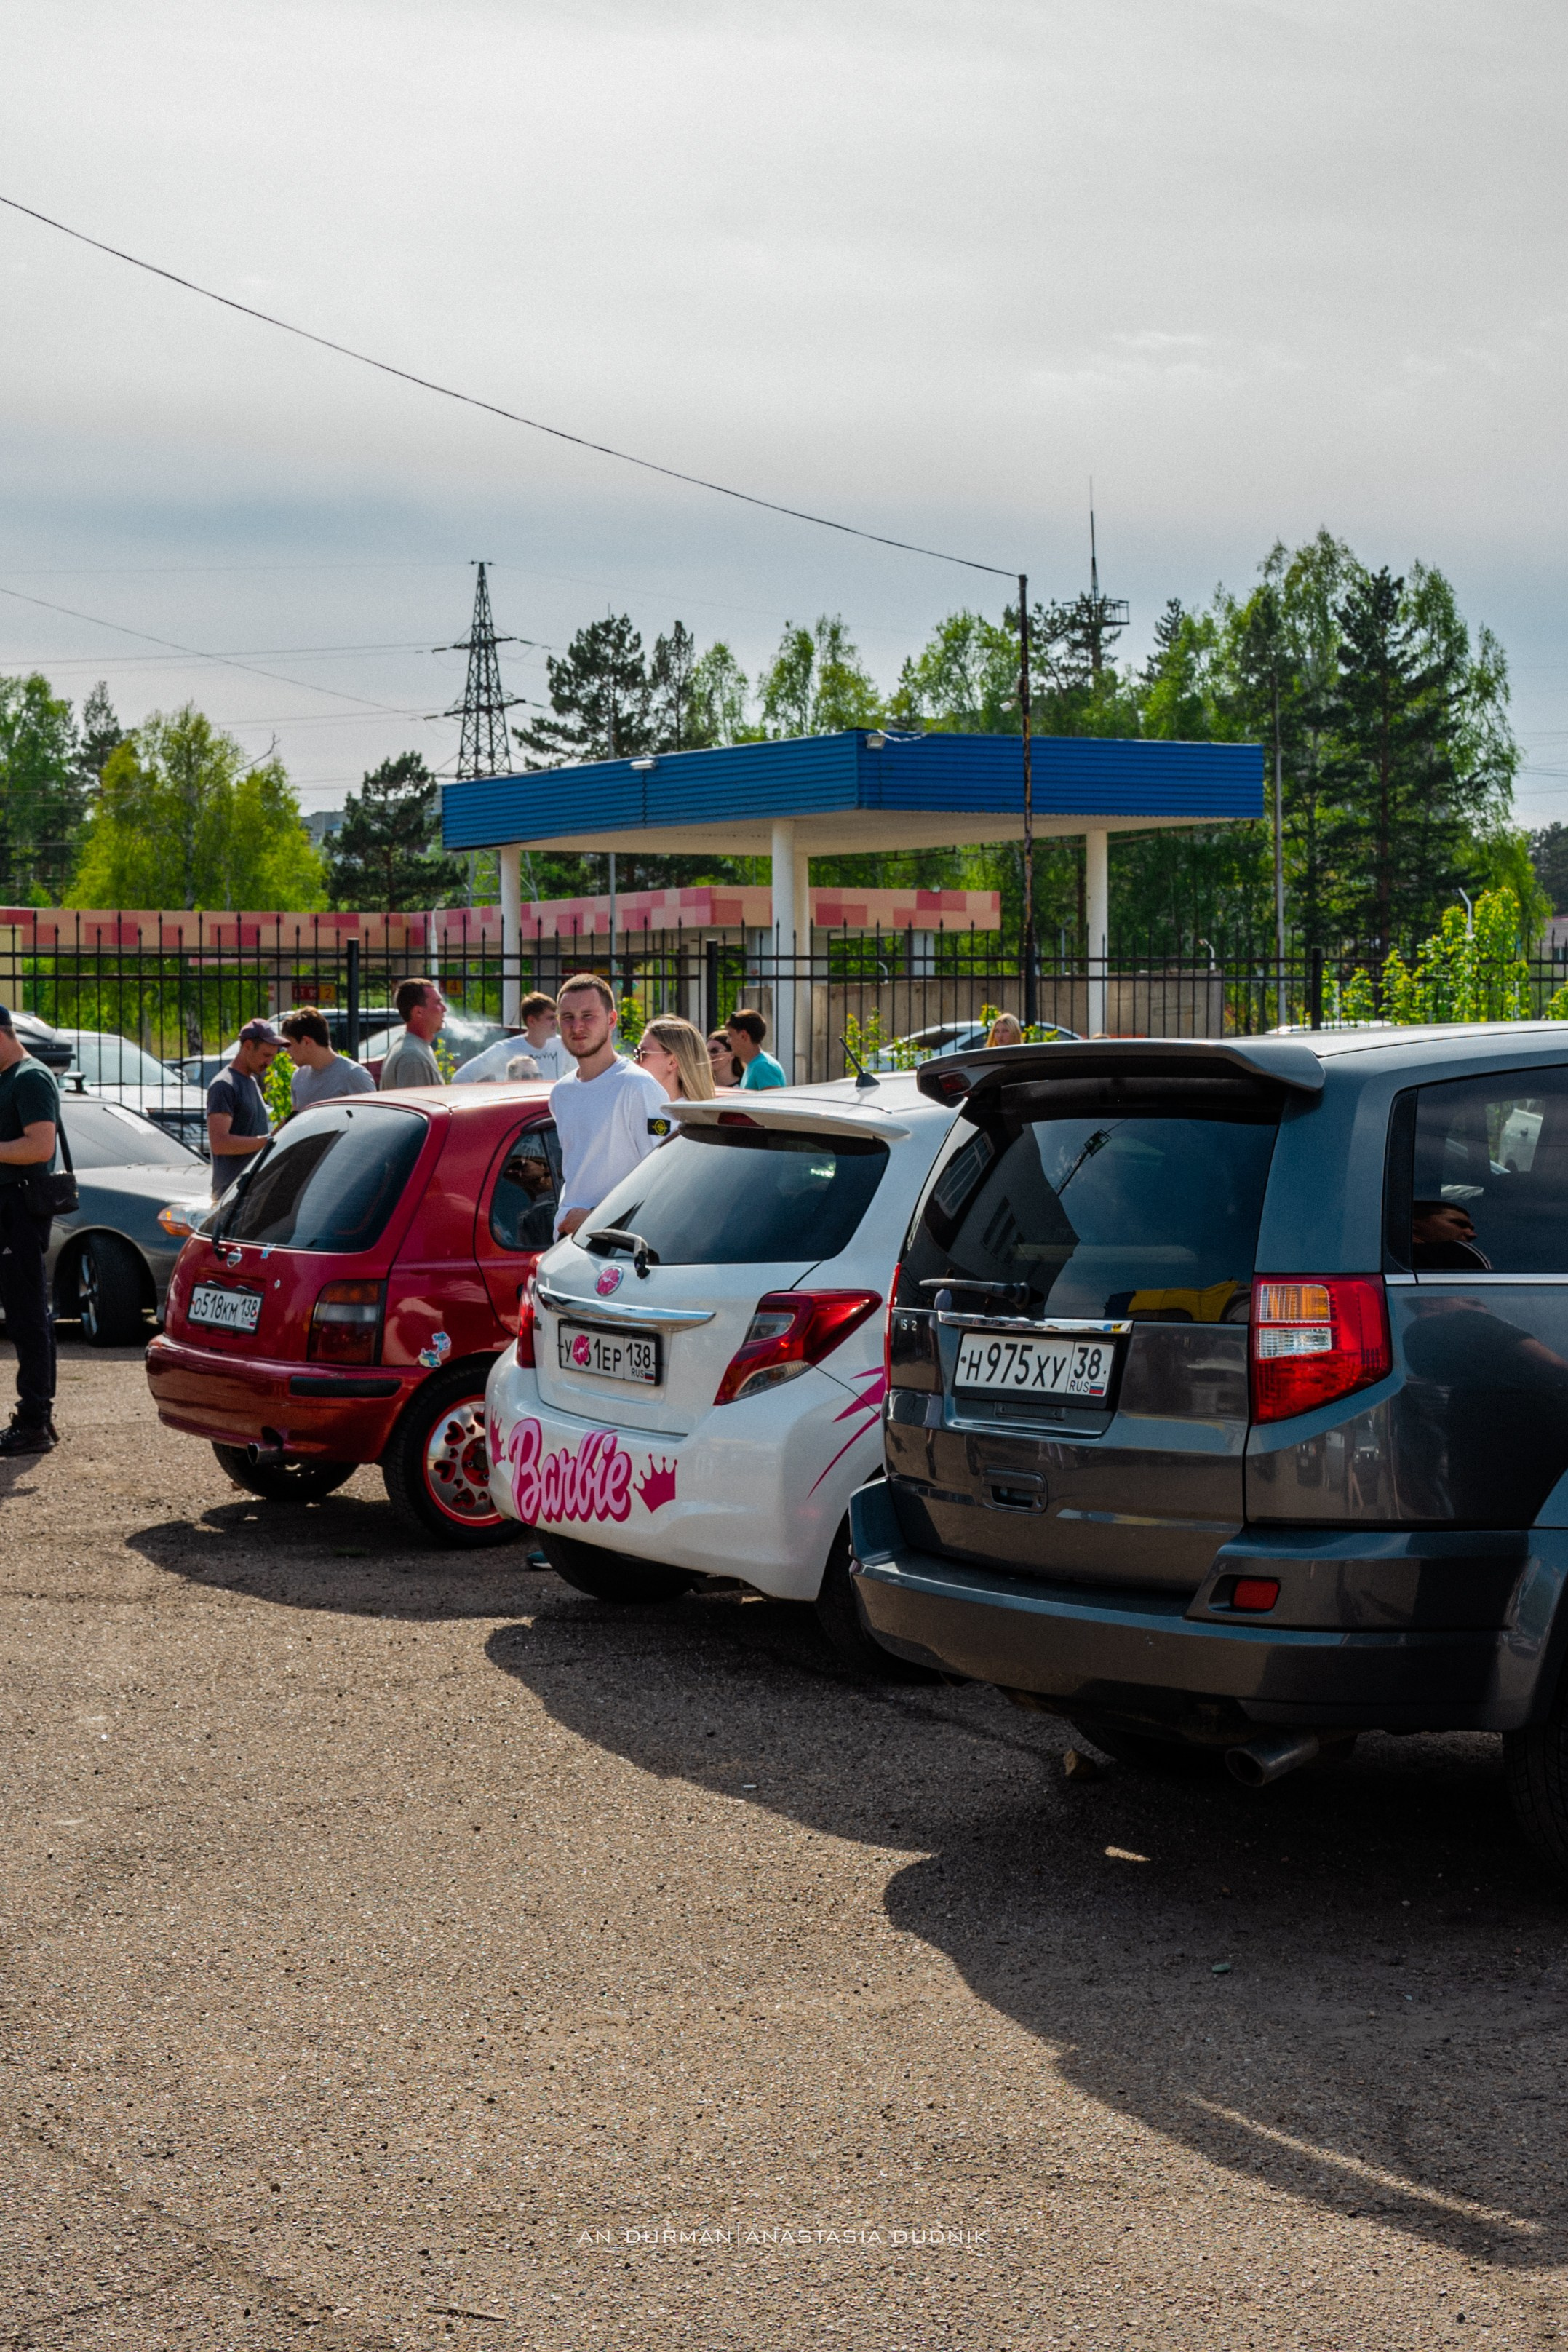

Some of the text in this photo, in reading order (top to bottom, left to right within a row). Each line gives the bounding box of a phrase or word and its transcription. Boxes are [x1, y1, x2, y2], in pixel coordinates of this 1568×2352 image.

[194, 1292, 258, 1322] О518КМ 138
[565, 1335, 651, 1372] У1ЕР 138
[966, 1342, 1102, 1388] Н975ХУ 38
[631, 1368, 645, 1378] RUS
[1069, 1380, 1089, 1393] RUS
[509, 1418, 632, 1527] Barbie
